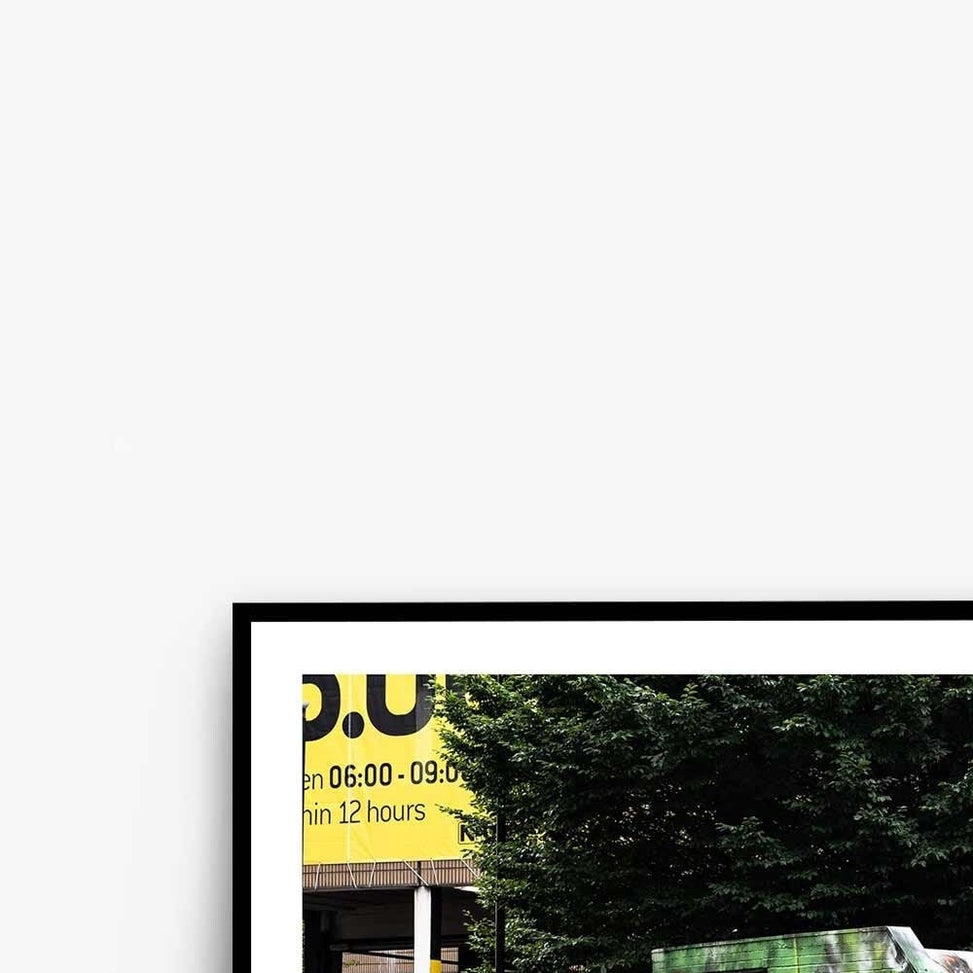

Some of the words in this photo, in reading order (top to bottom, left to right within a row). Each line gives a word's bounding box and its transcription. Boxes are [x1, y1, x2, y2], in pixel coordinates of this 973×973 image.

[329, 763, 392, 789] 06:00
[339, 799, 361, 824] 12
[367, 799, 426, 823] hours
